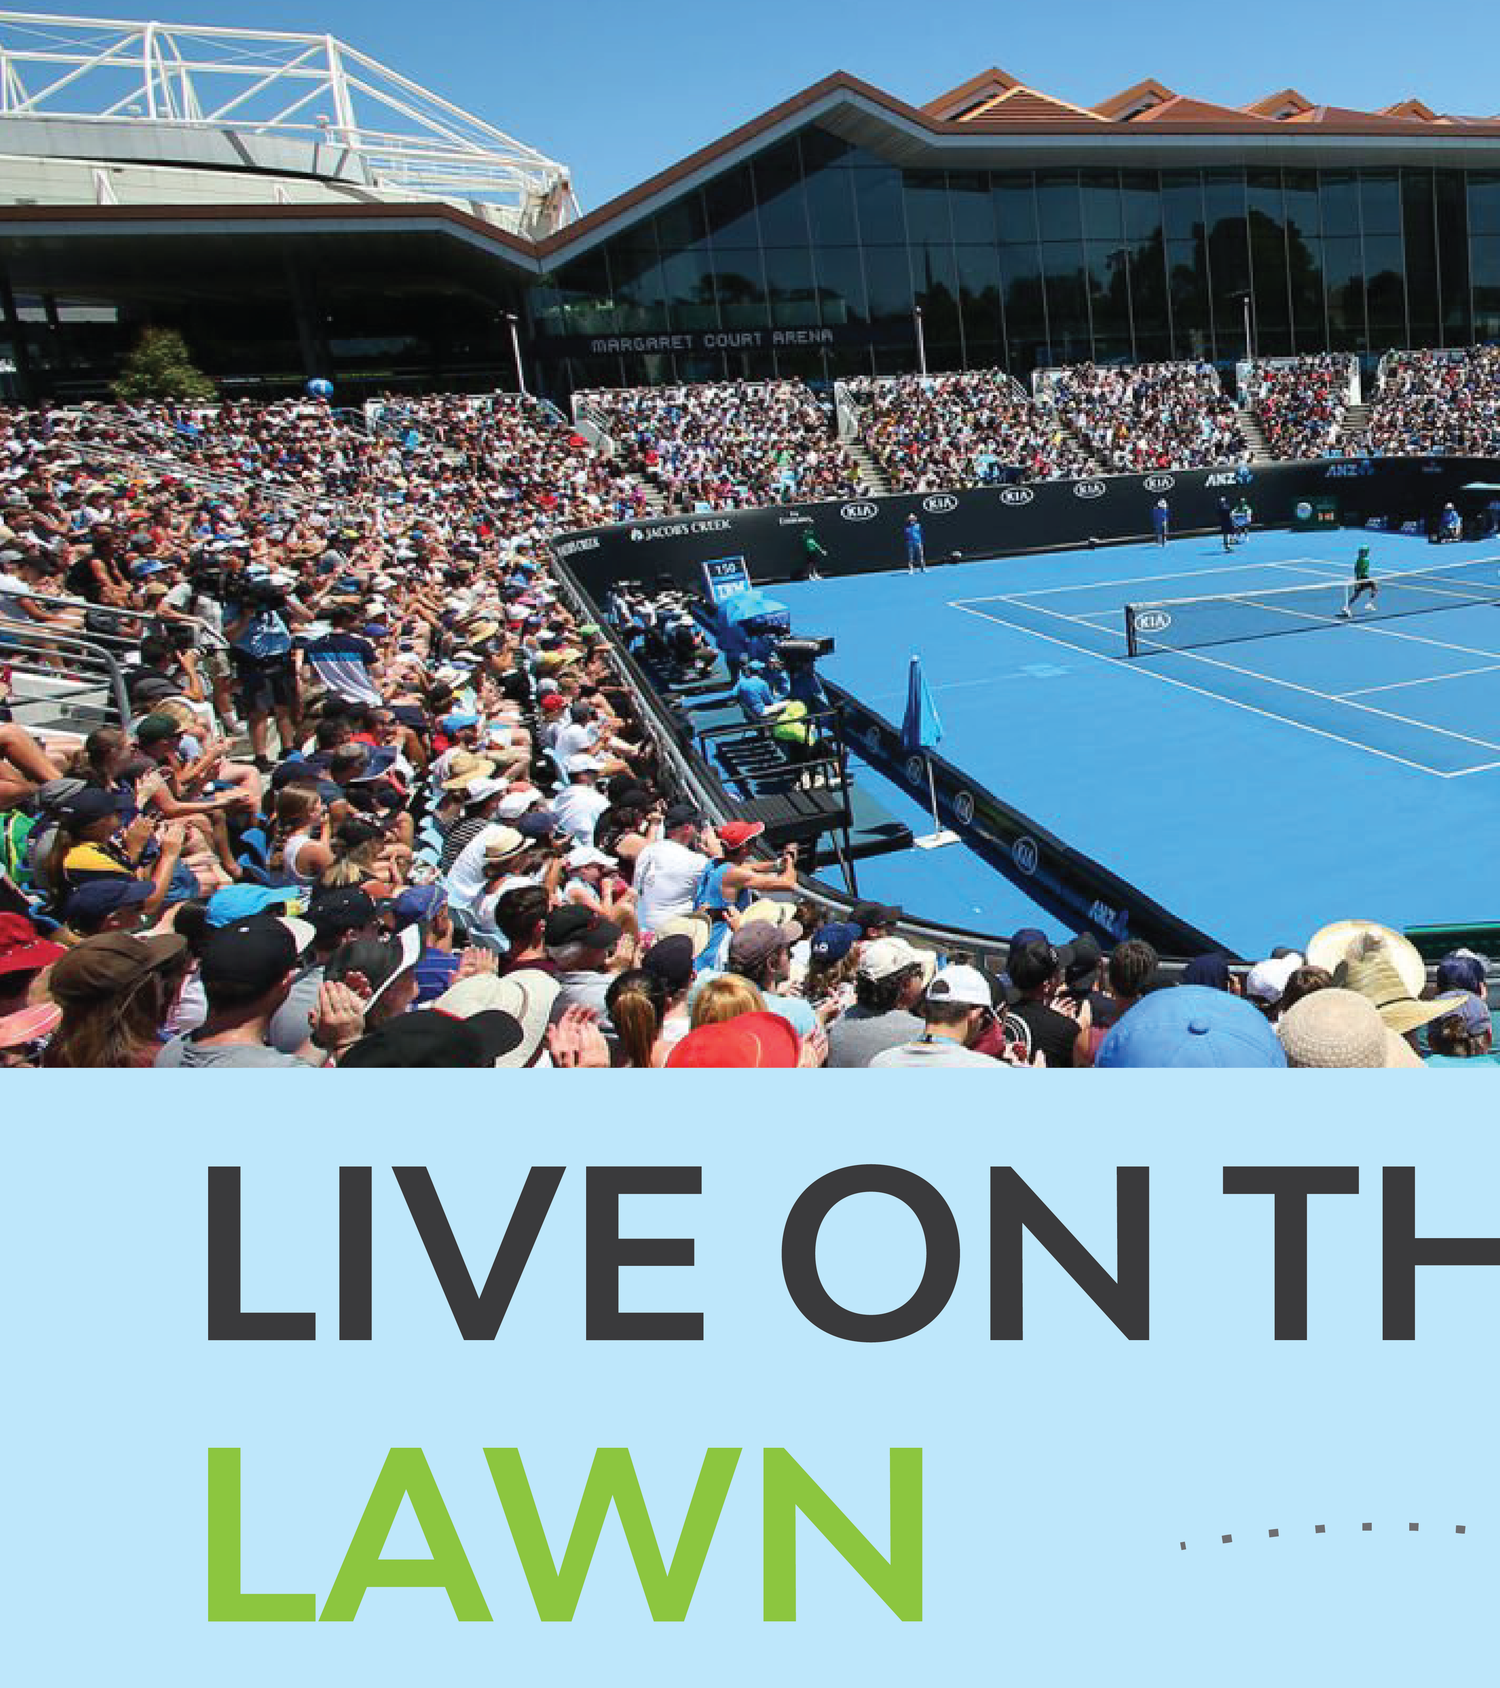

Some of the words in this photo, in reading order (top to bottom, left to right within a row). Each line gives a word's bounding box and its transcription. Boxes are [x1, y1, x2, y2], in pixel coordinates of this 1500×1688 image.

[591, 335, 692, 352] MARGARET
[704, 332, 762, 348] COURT
[772, 328, 834, 345] ARENA
[927, 496, 954, 511] KIA
[1004, 489, 1030, 503] KIA
[846, 504, 874, 518] KIA
[1138, 613, 1168, 629] KIA
